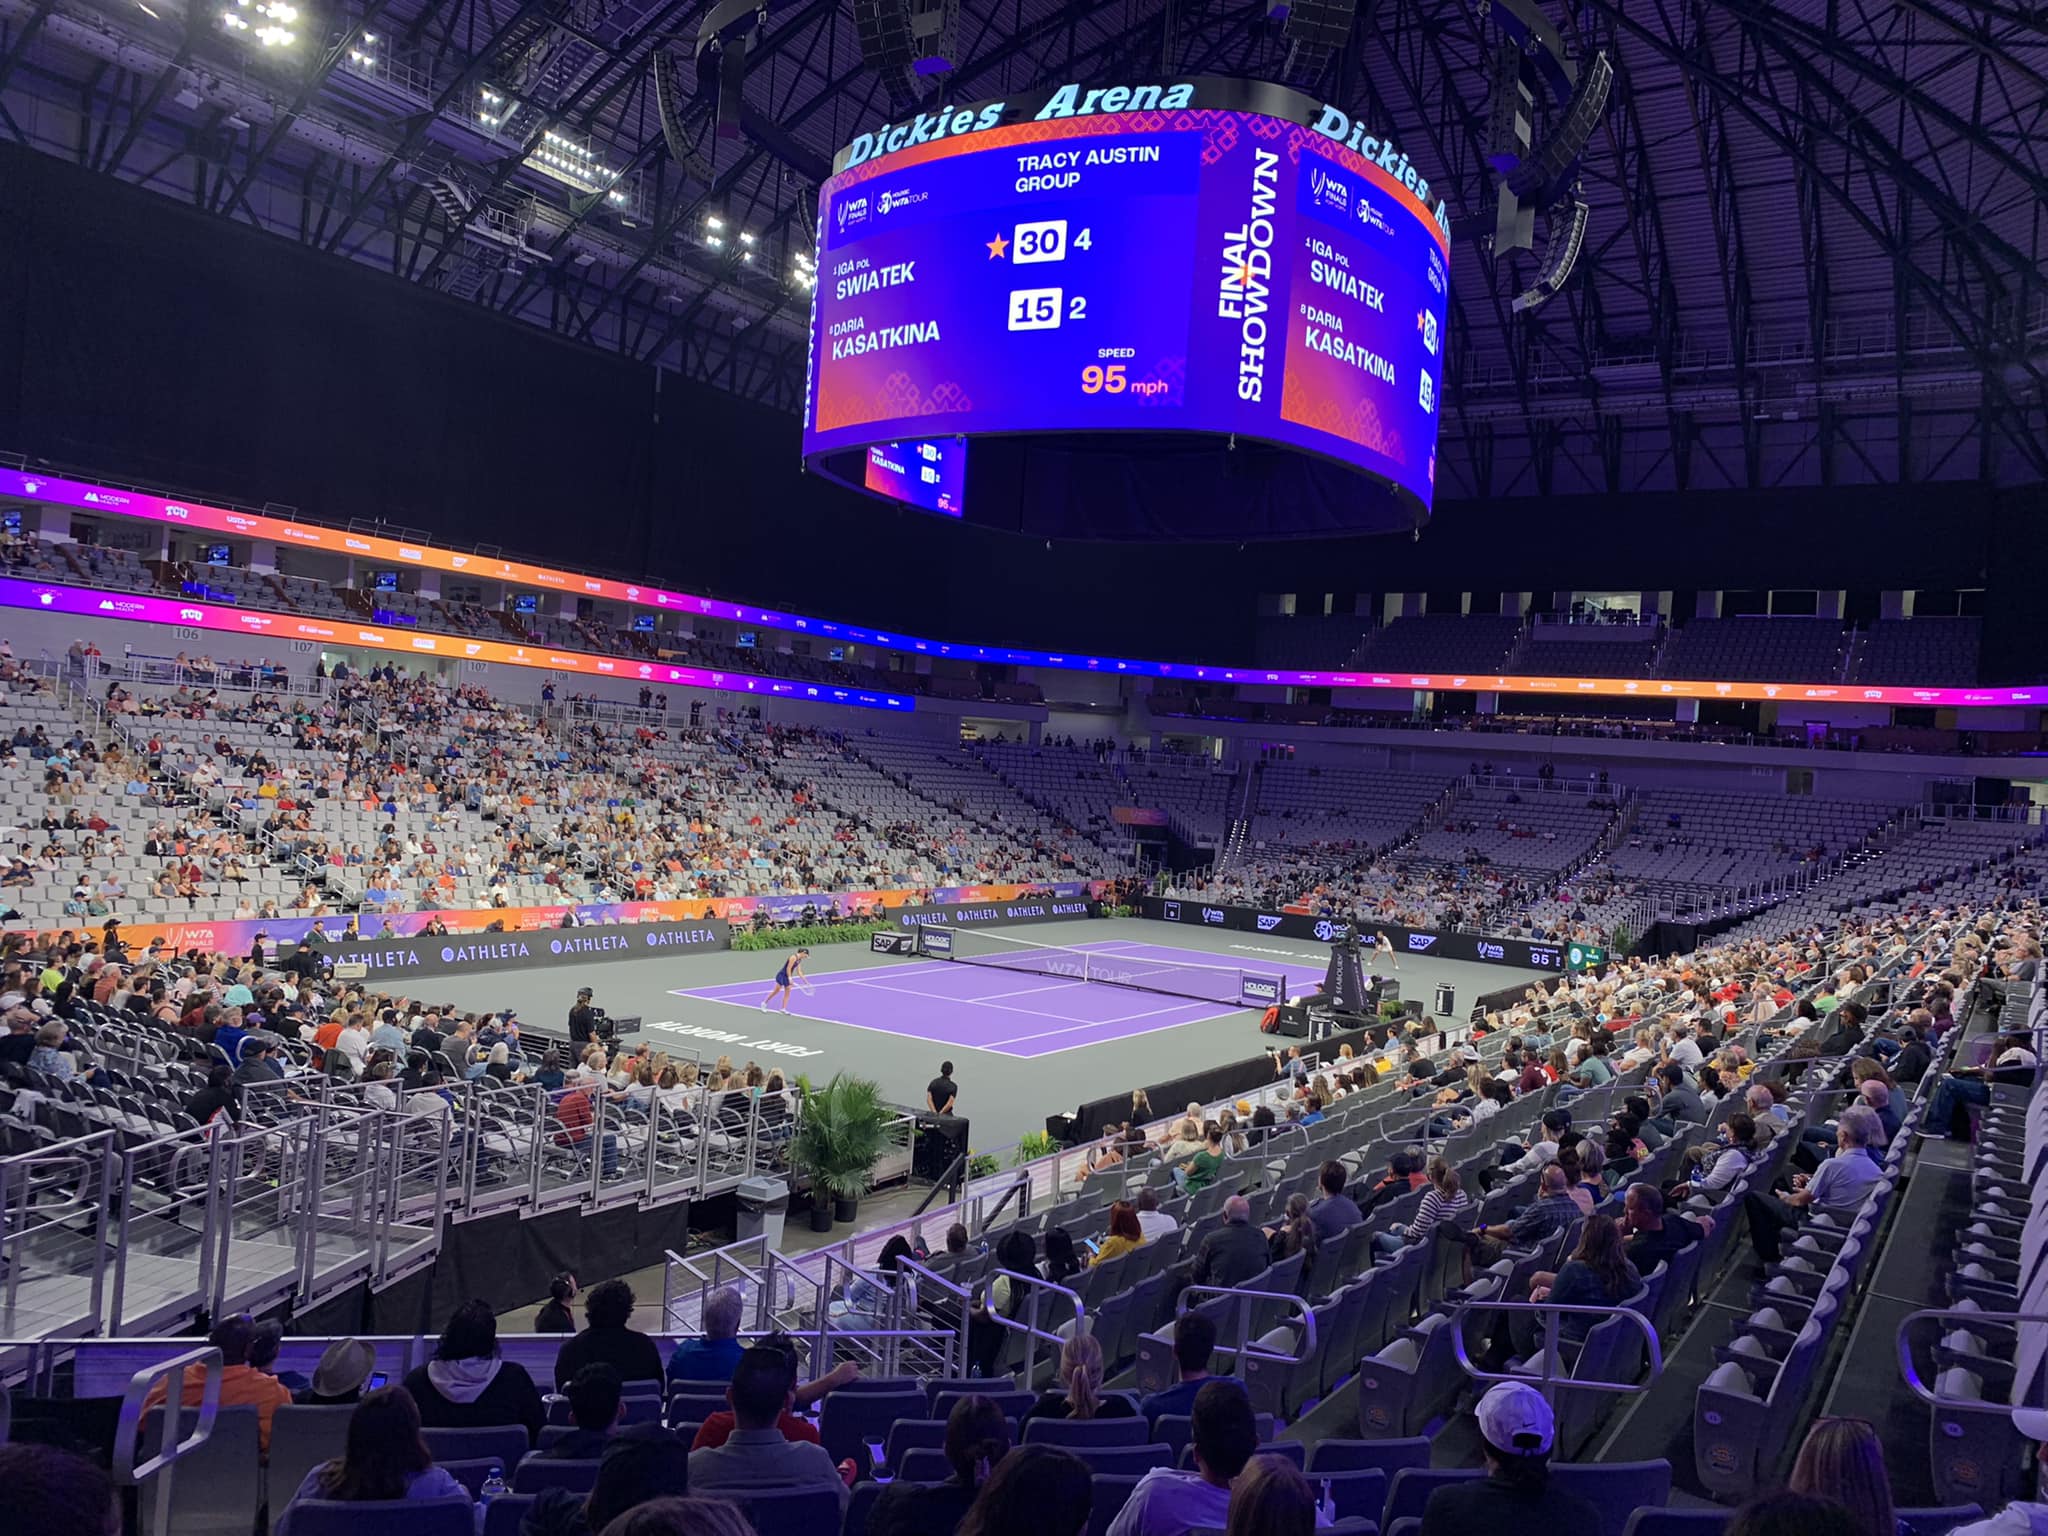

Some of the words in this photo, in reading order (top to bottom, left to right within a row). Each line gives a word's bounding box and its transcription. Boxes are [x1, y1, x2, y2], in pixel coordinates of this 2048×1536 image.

[845, 101, 1006, 169] Dickies
[1036, 83, 1194, 120] Arena
[1018, 152, 1082, 172] TRACY
[1087, 146, 1160, 166] AUSTIN
[1311, 103, 1429, 201] Dickies
[1015, 173, 1081, 193] GROUP
[1326, 178, 1347, 197] WTA
[849, 198, 868, 212] WTA
[1019, 230, 1059, 256] 30
[1074, 229, 1093, 251] 4
[1312, 239, 1333, 260] IGA
[1335, 253, 1350, 269] POL
[838, 259, 855, 277] IGA
[856, 258, 870, 271] POL
[1218, 224, 1249, 319] FINAL
[1238, 147, 1279, 403] SHOWDOWN
[836, 261, 915, 300] SWIATEK
[1311, 259, 1384, 313] SWIATEK
[1015, 297, 1054, 323] 15
[1069, 297, 1087, 320] 2
[1307, 307, 1343, 333] DARIA
[834, 317, 865, 337] DARIA
[832, 320, 941, 360] KASATKINA
[1098, 348, 1136, 358] SPEED
[1305, 326, 1395, 386] KASATKINA
[1081, 365, 1126, 395] 95
[1132, 380, 1169, 396] mph
[166, 505, 188, 519] TCU
[180, 609, 204, 622] TCU
[175, 627, 199, 640] 106
[294, 642, 313, 652] 107
[470, 661, 486, 671] 107
[555, 672, 568, 681] 108
[909, 912, 948, 926] ATHLETA
[965, 909, 998, 921] ATHLETA
[1012, 906, 1045, 917] ATHLETA
[1057, 903, 1088, 914] ATHLETA
[1258, 918, 1276, 928] SAP
[185, 929, 215, 939] WTA
[874, 937, 891, 948] SAP
[1409, 936, 1430, 946] SAP
[337, 951, 420, 968] ATHLETA
[456, 943, 530, 961] ATHLETA
[564, 936, 628, 953] ATHLETA
[657, 929, 715, 945] ATHLETA
[1531, 953, 1549, 965] 95
[1244, 981, 1277, 992] HOLOGIC
[646, 1021, 748, 1043] WORTH
[737, 1040, 825, 1058] FORT
